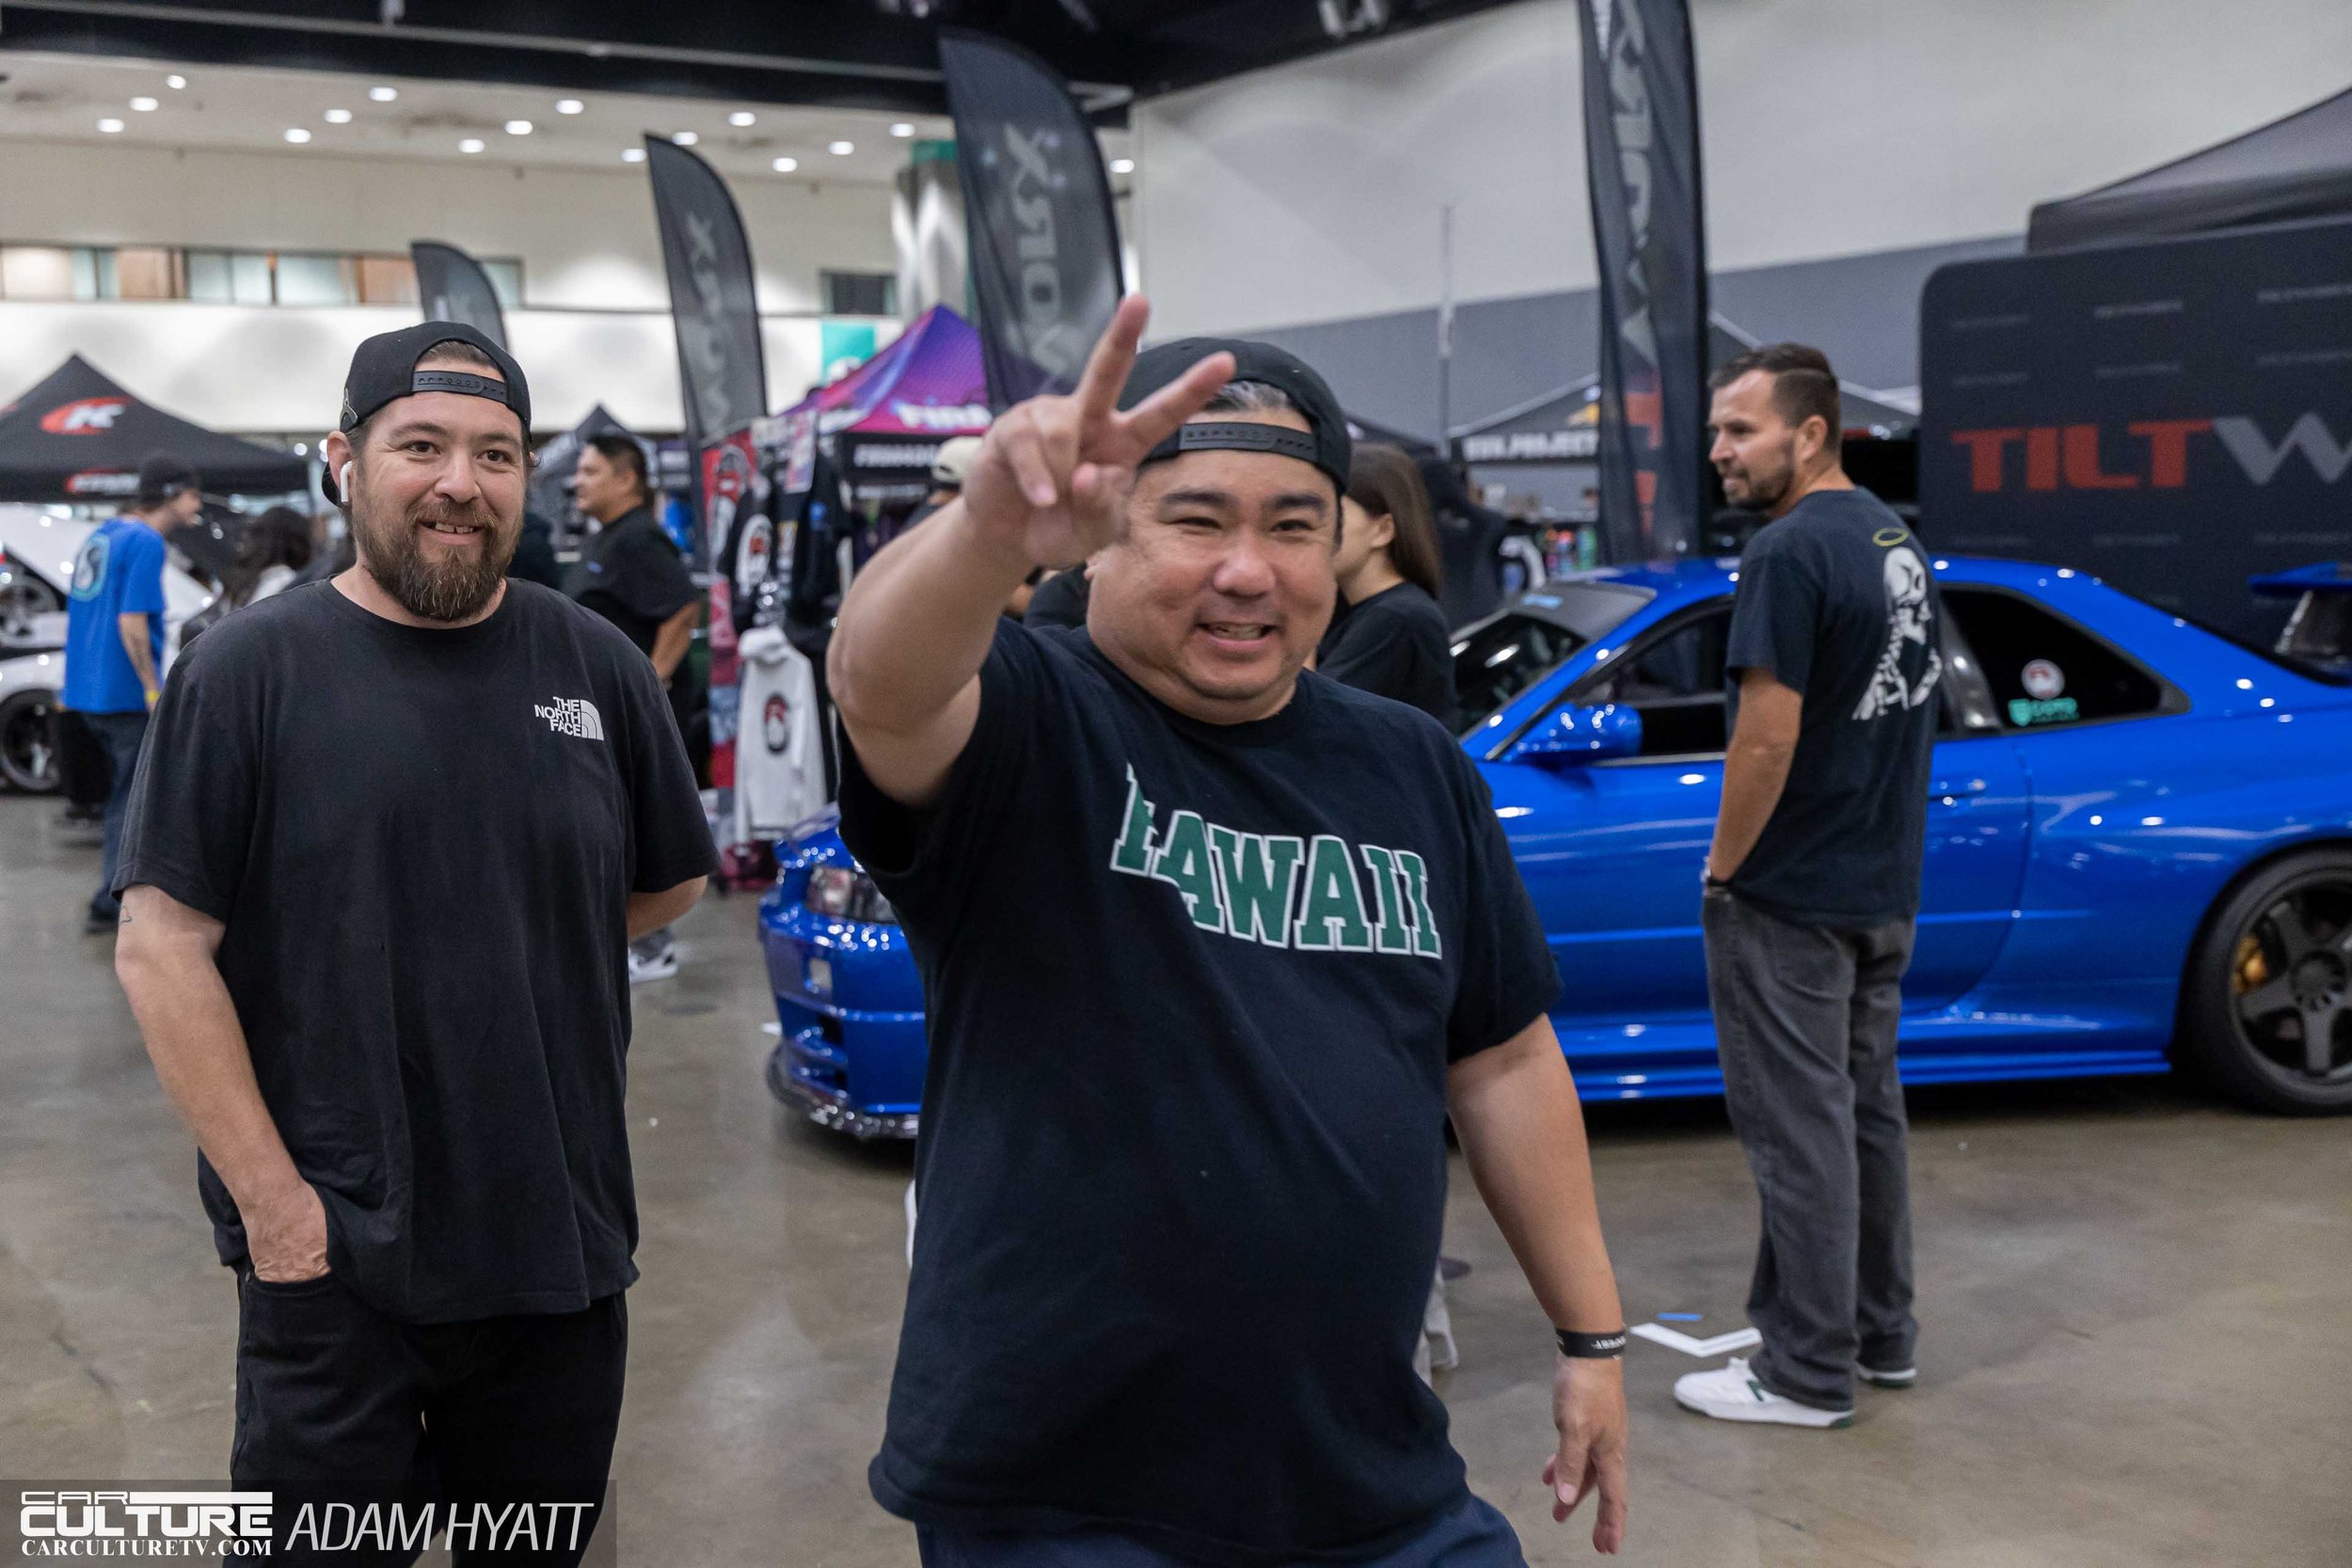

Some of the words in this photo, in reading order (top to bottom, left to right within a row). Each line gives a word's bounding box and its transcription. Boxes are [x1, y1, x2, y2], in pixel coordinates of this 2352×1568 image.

[552, 696, 580, 712] THE
[533, 705, 581, 724] NORTH
[549, 719, 581, 737] FACE
